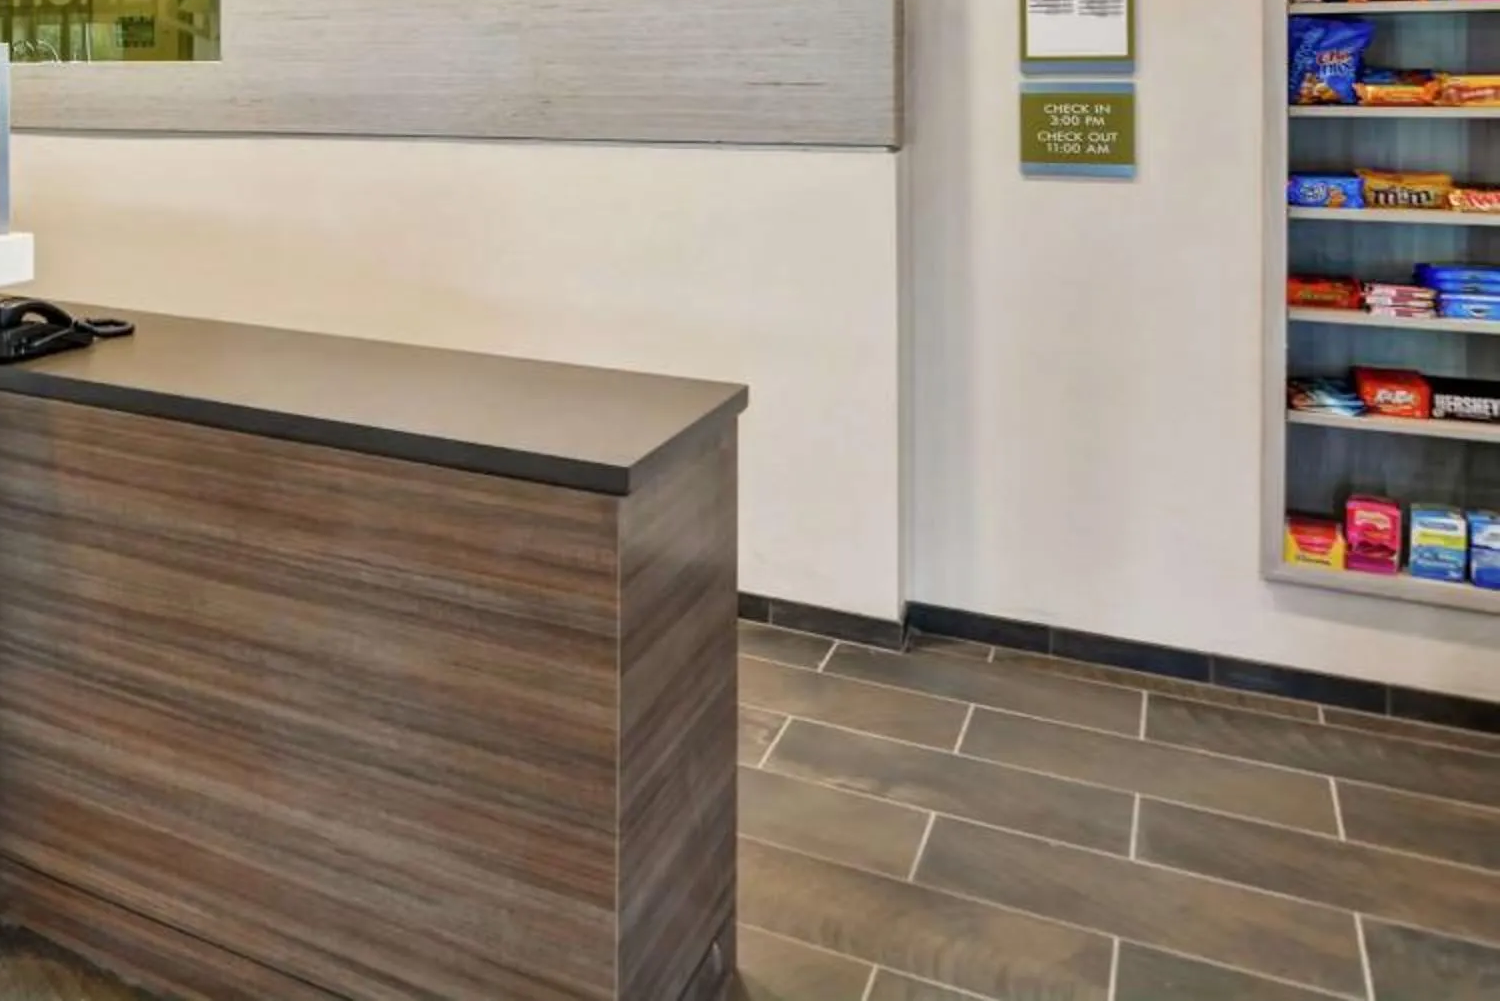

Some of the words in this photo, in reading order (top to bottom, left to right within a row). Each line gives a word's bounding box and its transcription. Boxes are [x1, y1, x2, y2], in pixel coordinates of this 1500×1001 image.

[1043, 103, 1090, 115] CHECK
[1094, 103, 1111, 115] IN
[1049, 114, 1080, 126] 3:00
[1085, 115, 1105, 126] PM
[1037, 130, 1083, 142] CHECK
[1087, 132, 1118, 142] OUT
[1046, 143, 1080, 154] 11:00
[1086, 143, 1110, 155] AM
